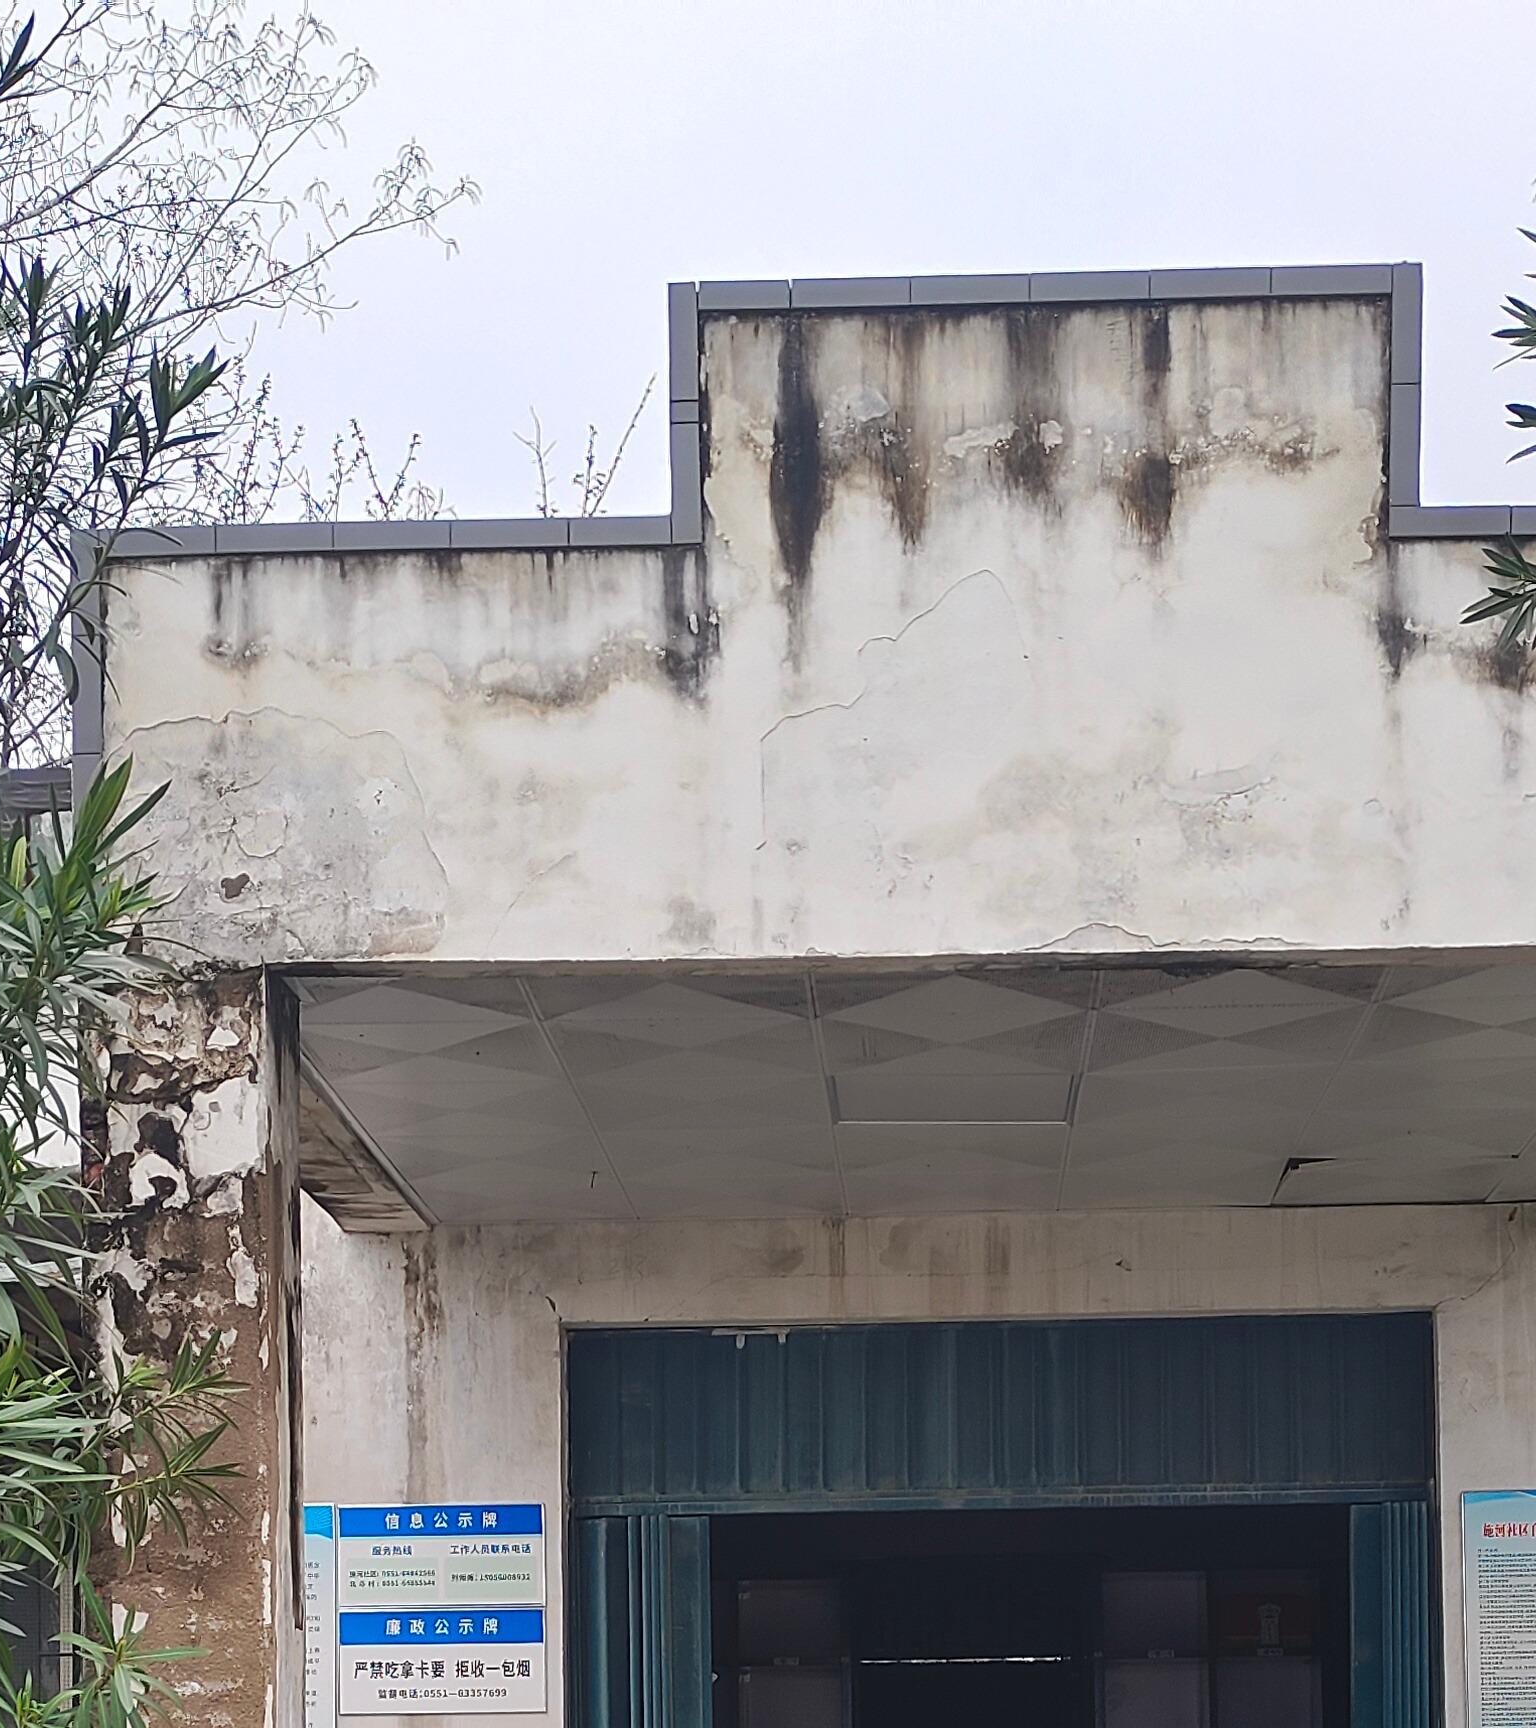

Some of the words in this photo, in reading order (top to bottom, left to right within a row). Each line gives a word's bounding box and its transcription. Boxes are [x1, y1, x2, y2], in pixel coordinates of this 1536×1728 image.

[385, 1512, 498, 1530] 信息公示牌
[372, 1545, 412, 1556] 服务热线
[450, 1543, 531, 1555] 工作人员联系电话
[386, 1618, 498, 1636] 廉政公示牌
[354, 1660, 445, 1679] 严禁吃拿卡要
[455, 1659, 531, 1679] 拒收一包烟
